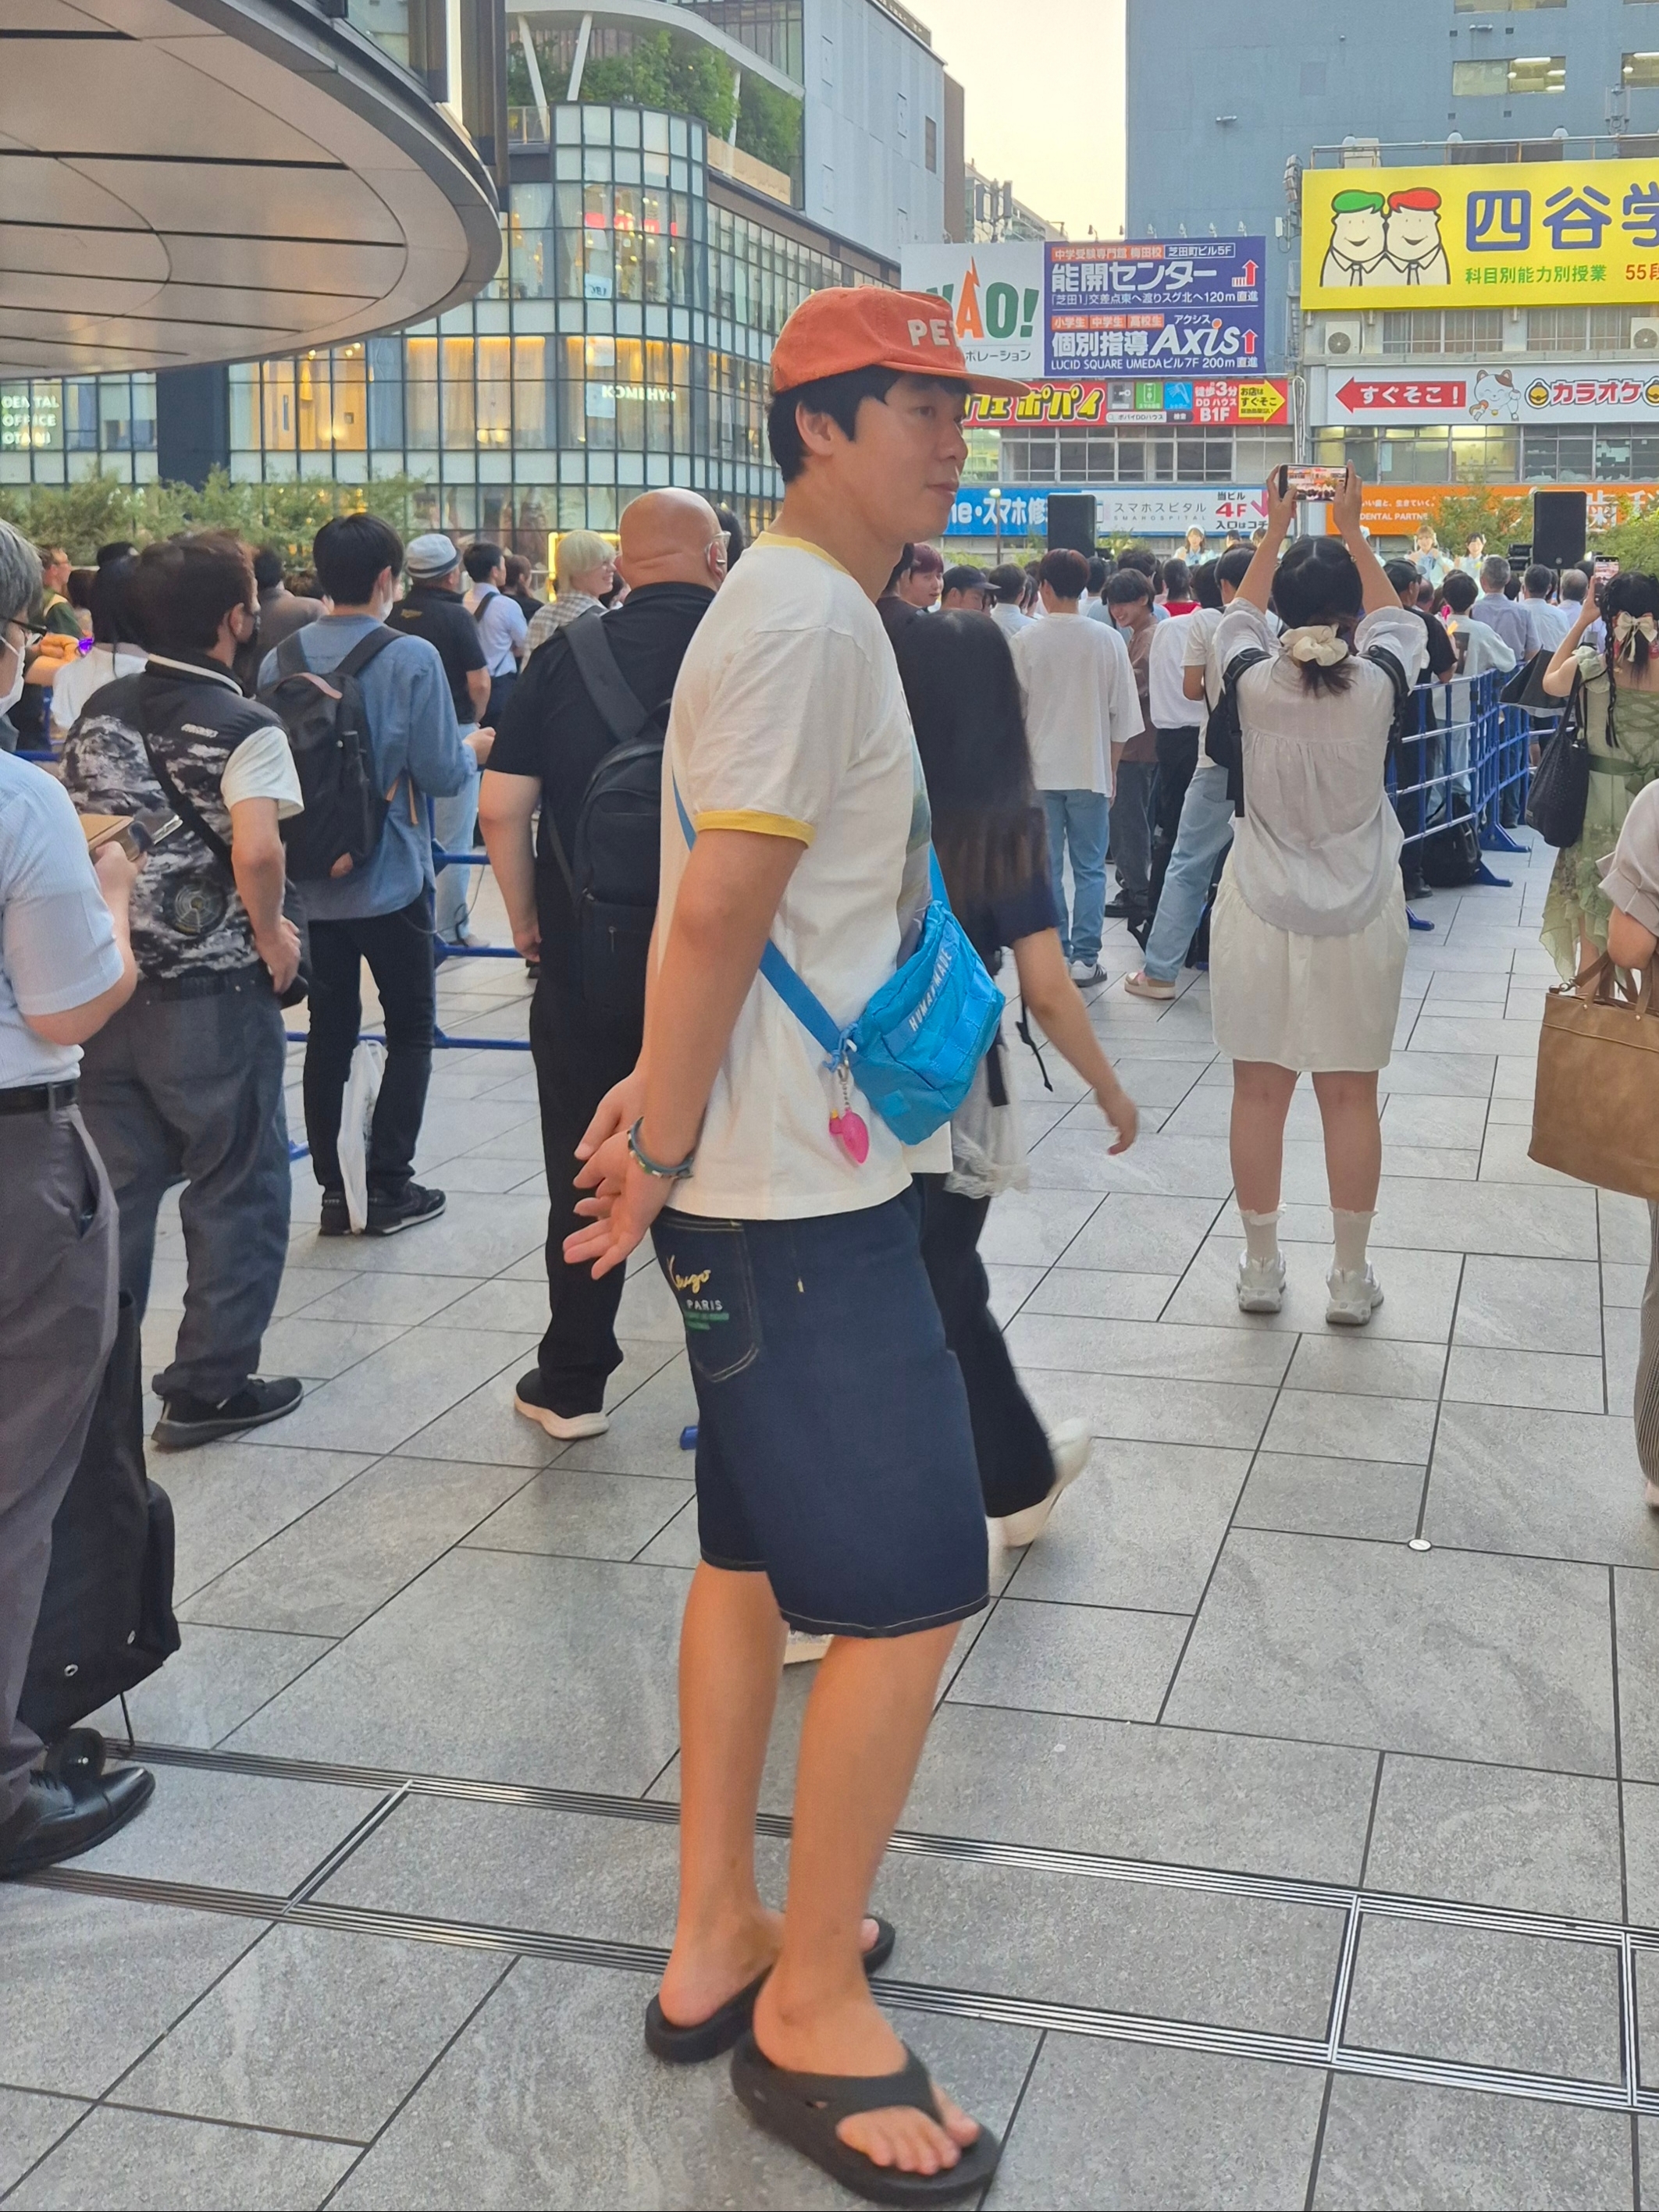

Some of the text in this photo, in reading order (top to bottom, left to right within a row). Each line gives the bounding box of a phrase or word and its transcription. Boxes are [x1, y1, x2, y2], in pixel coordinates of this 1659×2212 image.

[1465, 181, 1659, 251] 四谷学
[1052, 261, 1217, 292] 能開センター
[1465, 265, 1607, 284] 科目別能力別授業
[1055, 315, 1211, 329] 小学生 中学生 高校生 アクシス
[1052, 331, 1149, 357] 個別指導
[1051, 359, 1080, 370] LUCID
[1084, 359, 1123, 370] SQUARE
[1202, 357, 1235, 368] 200m
[1241, 387, 1264, 396] お店は
[1551, 380, 1643, 405] カラオケ
[1017, 386, 1101, 417] ポパイ
[1241, 397, 1277, 407] すぐそこ
[1200, 407, 1230, 421] B1F
[1217, 491, 1245, 501] 当ビル
[1114, 503, 1207, 513] スマホスピタル
[686, 1299, 723, 1311] PARIS
